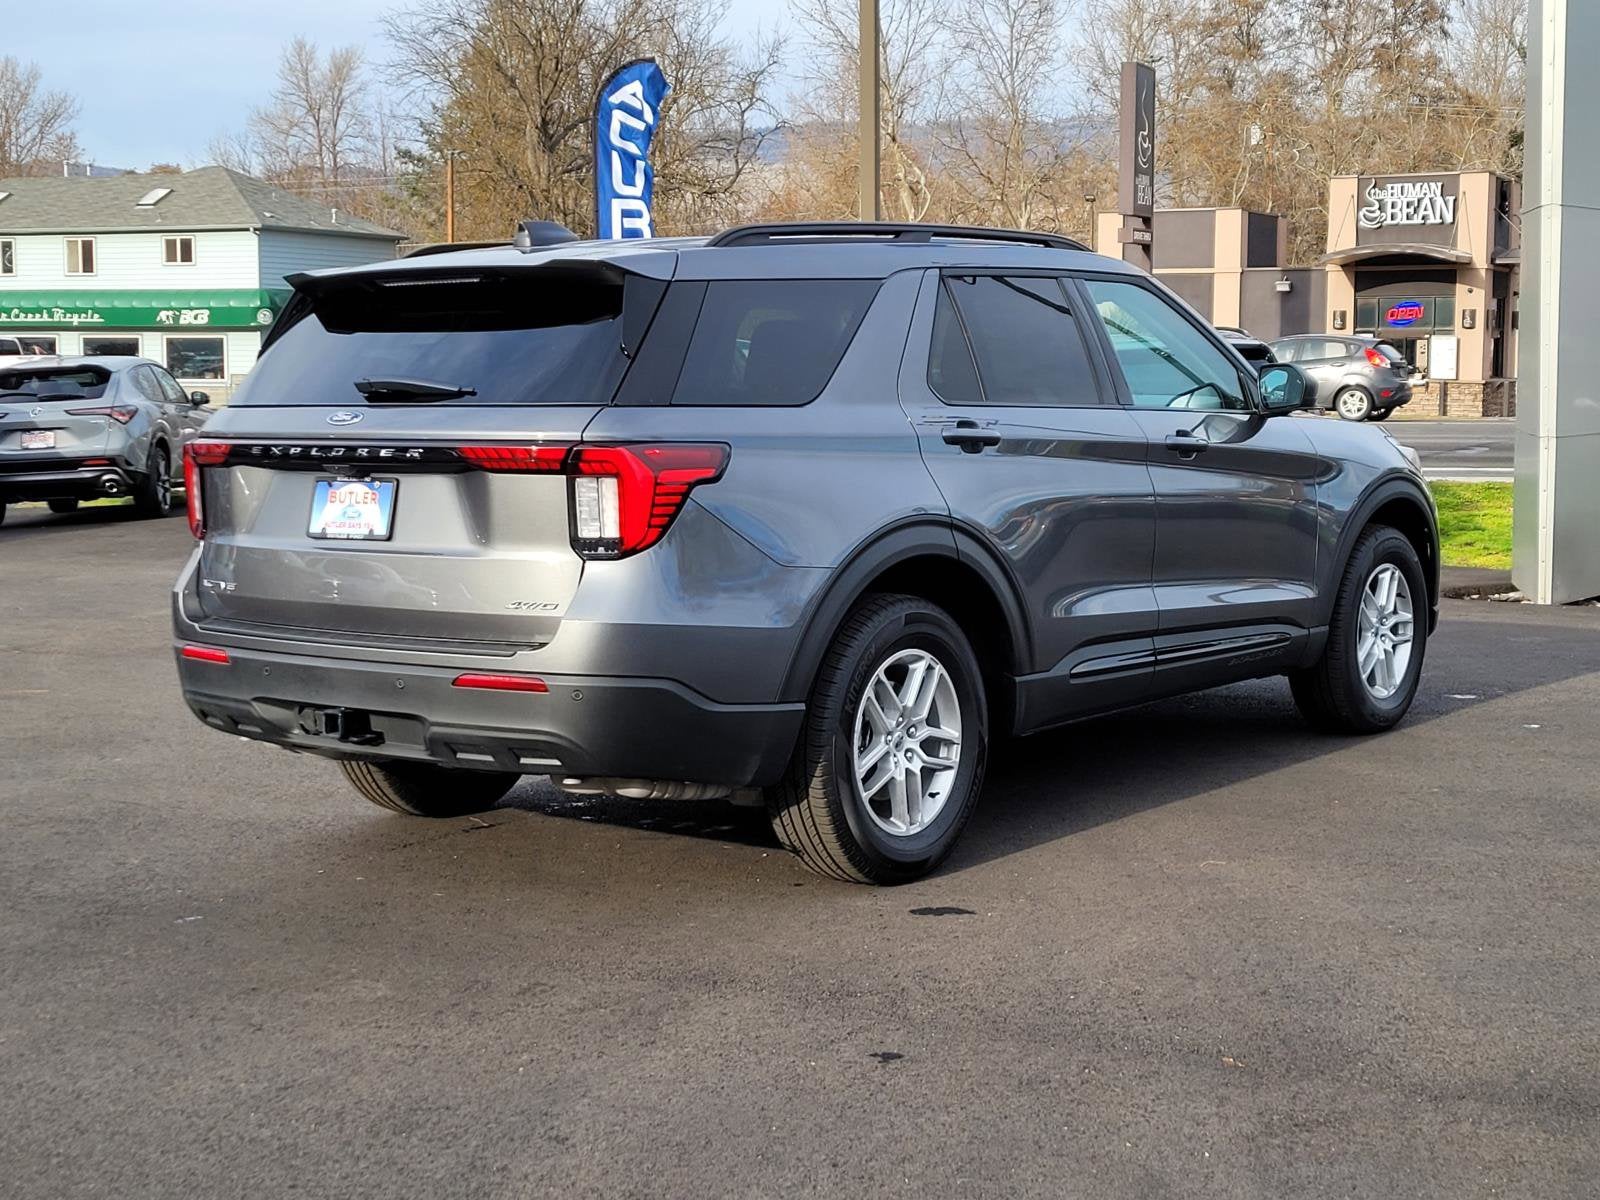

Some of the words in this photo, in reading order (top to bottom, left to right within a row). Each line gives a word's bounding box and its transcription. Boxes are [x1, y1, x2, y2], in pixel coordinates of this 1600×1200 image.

[1371, 188, 1387, 200] the
[1386, 182, 1443, 199] HUMAN
[1383, 195, 1456, 225] BEAN
[52, 308, 104, 326] Bicycle
[1385, 306, 1424, 321] OPEN
[251, 446, 424, 459] EXPLORER
[329, 490, 378, 505] BUTLER
